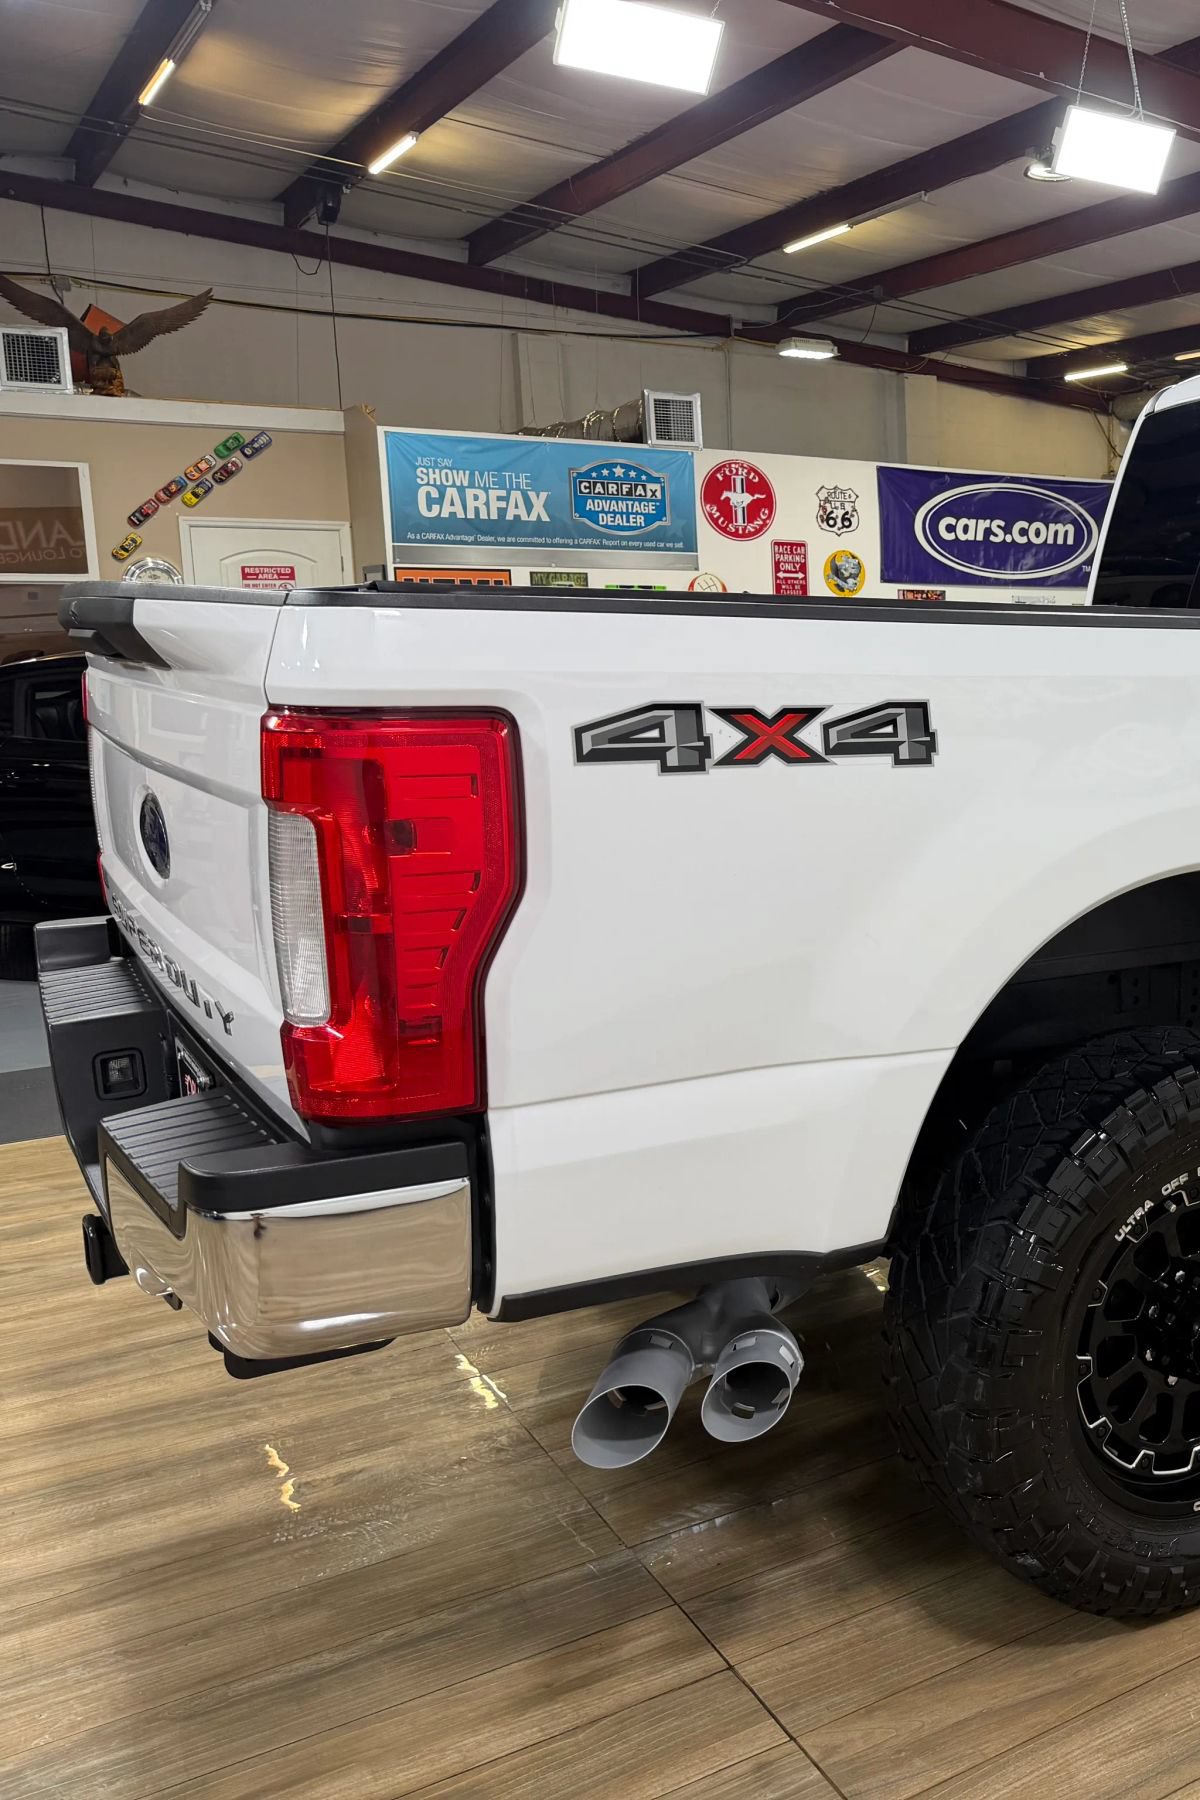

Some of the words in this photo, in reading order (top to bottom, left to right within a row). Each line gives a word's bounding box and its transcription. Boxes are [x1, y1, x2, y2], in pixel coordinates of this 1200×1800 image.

[415, 457, 435, 466] JUST
[438, 458, 452, 467] SAY
[416, 467, 470, 486] SHOW
[475, 471, 498, 488] ME
[502, 472, 532, 489] THE
[716, 465, 759, 483] FORD
[580, 482, 659, 498] CARFAX
[827, 491, 848, 500] ROUTE
[417, 485, 551, 522] CARFAX
[586, 499, 657, 513] ADVANTAGE
[598, 513, 645, 526] DEALER
[706, 503, 769, 533] MUSTANG
[826, 510, 852, 528] 66
[938, 516, 1074, 545] cars.com
[421, 532, 444, 540] CARFAX
[552, 537, 573, 545] offering
[774, 545, 791, 553] RACE
[793, 546, 805, 554] CAR
[775, 554, 805, 563] PARKING
[780, 563, 801, 571] ONLY
[532, 573, 546, 585] MY
[1114, 1200, 1154, 1242] ULTRA
[1161, 1173, 1189, 1196] OFF
